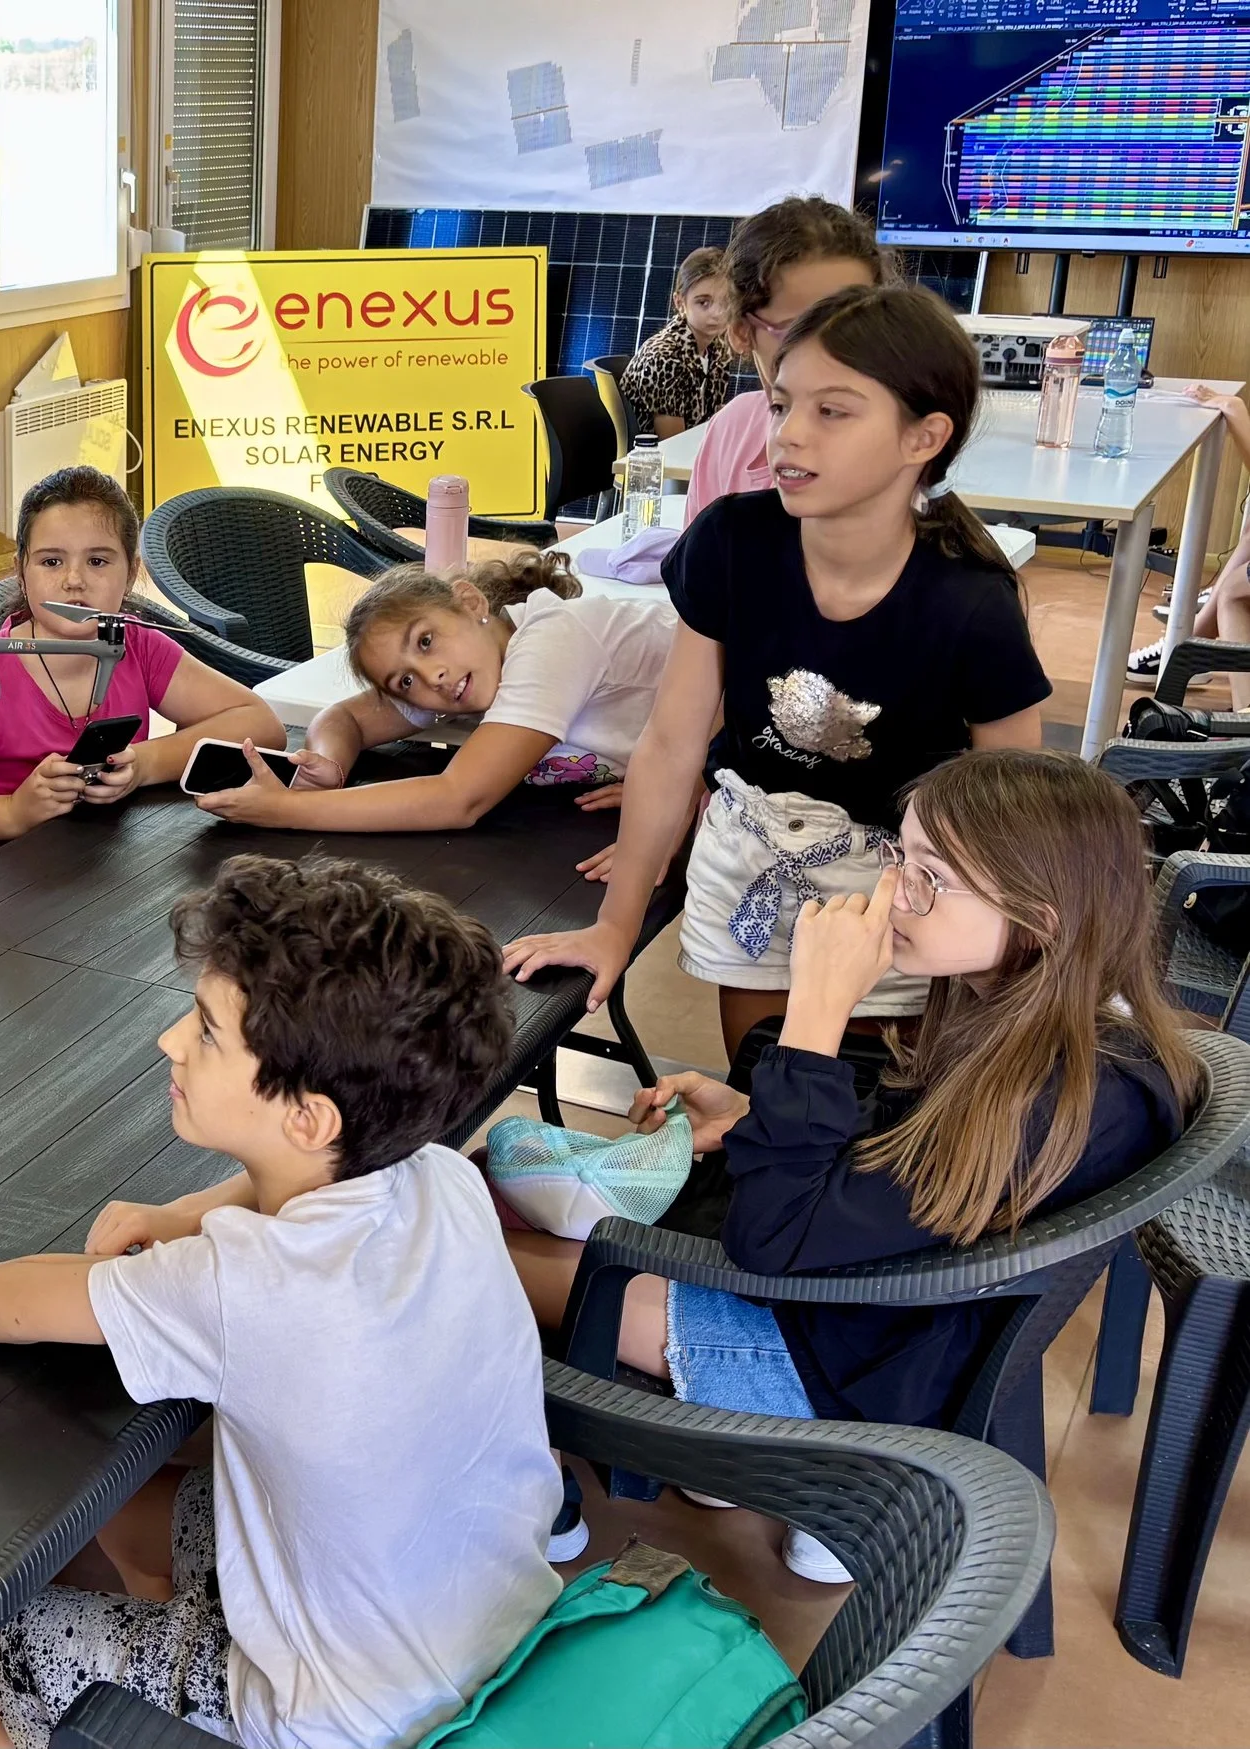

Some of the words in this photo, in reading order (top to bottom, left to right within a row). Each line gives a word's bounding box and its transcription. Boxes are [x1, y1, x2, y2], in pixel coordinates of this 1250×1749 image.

[274, 288, 515, 330] enexus
[317, 355, 378, 374] power
[384, 350, 403, 368] of
[408, 348, 509, 367] renewable
[174, 417, 276, 439] ENEXUS
[286, 411, 444, 435] RENEWABLE
[451, 409, 515, 431] S.R.L
[244, 444, 332, 466] SOLAR
[340, 440, 445, 463] ENERGY
[7, 641, 24, 650] AIR
